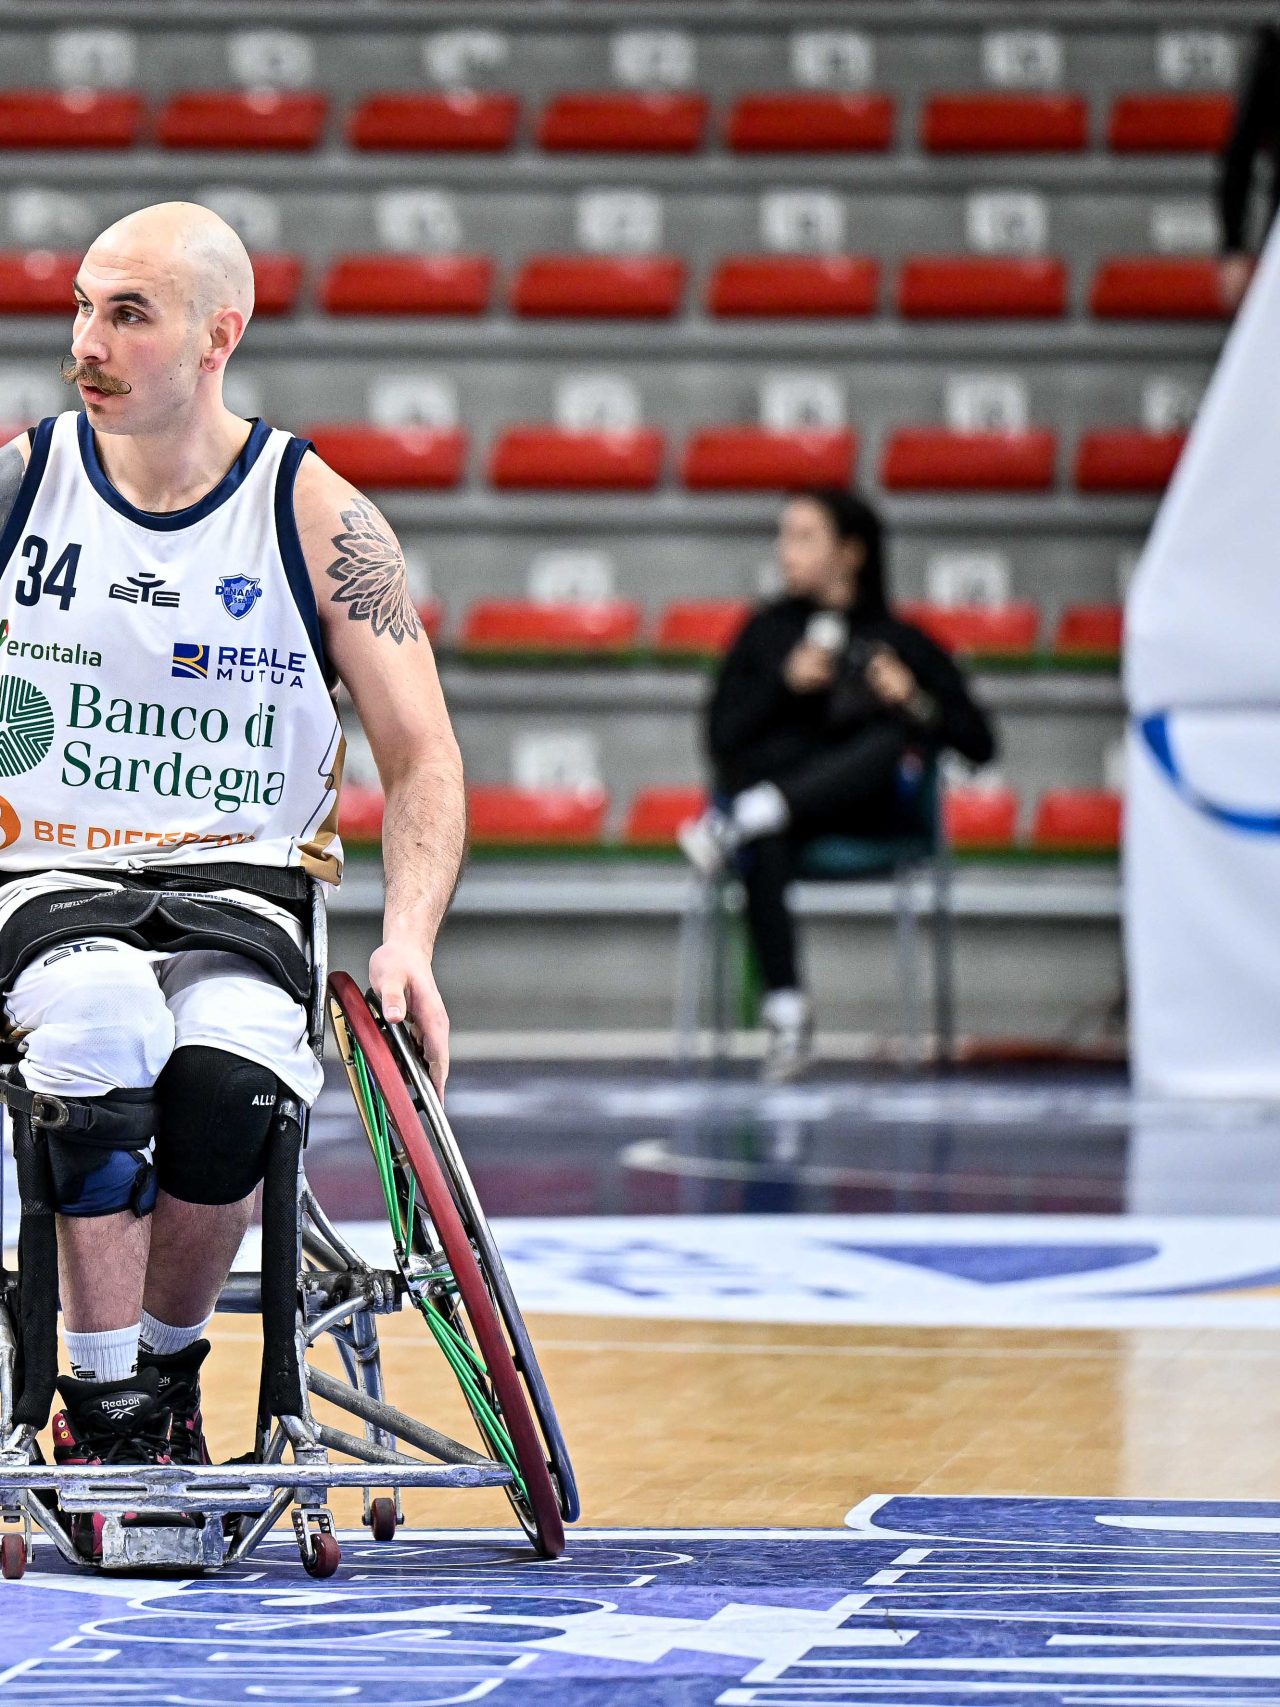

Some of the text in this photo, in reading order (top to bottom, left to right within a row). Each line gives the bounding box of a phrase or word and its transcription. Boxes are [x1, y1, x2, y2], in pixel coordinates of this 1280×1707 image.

[15, 534, 82, 611] 34
[218, 646, 307, 673] REALE
[216, 668, 305, 689] MUTUA
[66, 682, 276, 749] Banco di
[61, 741, 285, 813] Sardegna
[34, 820, 77, 847] BE
[101, 1397, 141, 1411] Reebok
